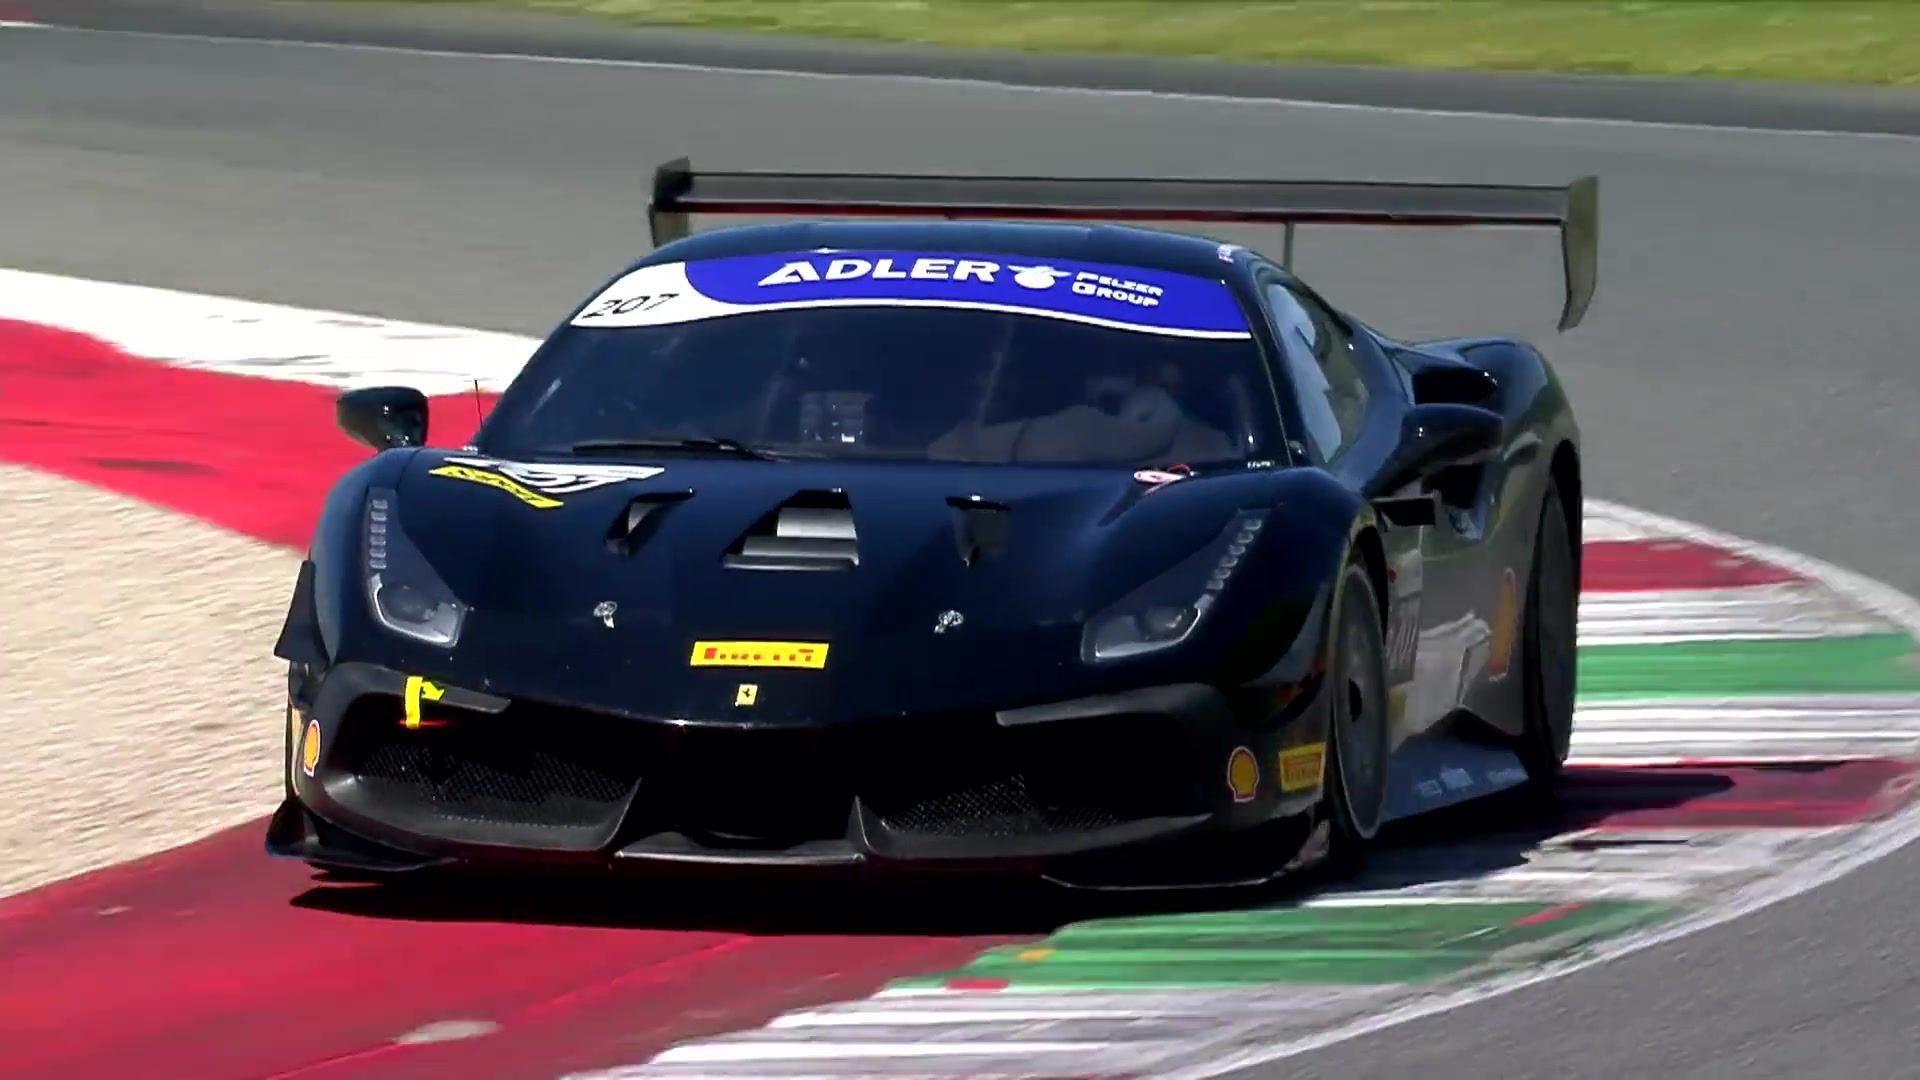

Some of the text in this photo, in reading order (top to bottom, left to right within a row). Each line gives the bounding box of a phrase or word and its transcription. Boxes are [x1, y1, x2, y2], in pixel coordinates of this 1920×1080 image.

[758, 259, 1000, 286] ADLER
[1076, 272, 1164, 296] PELZER
[581, 293, 679, 319] 207
[1072, 281, 1159, 307] GROUP
